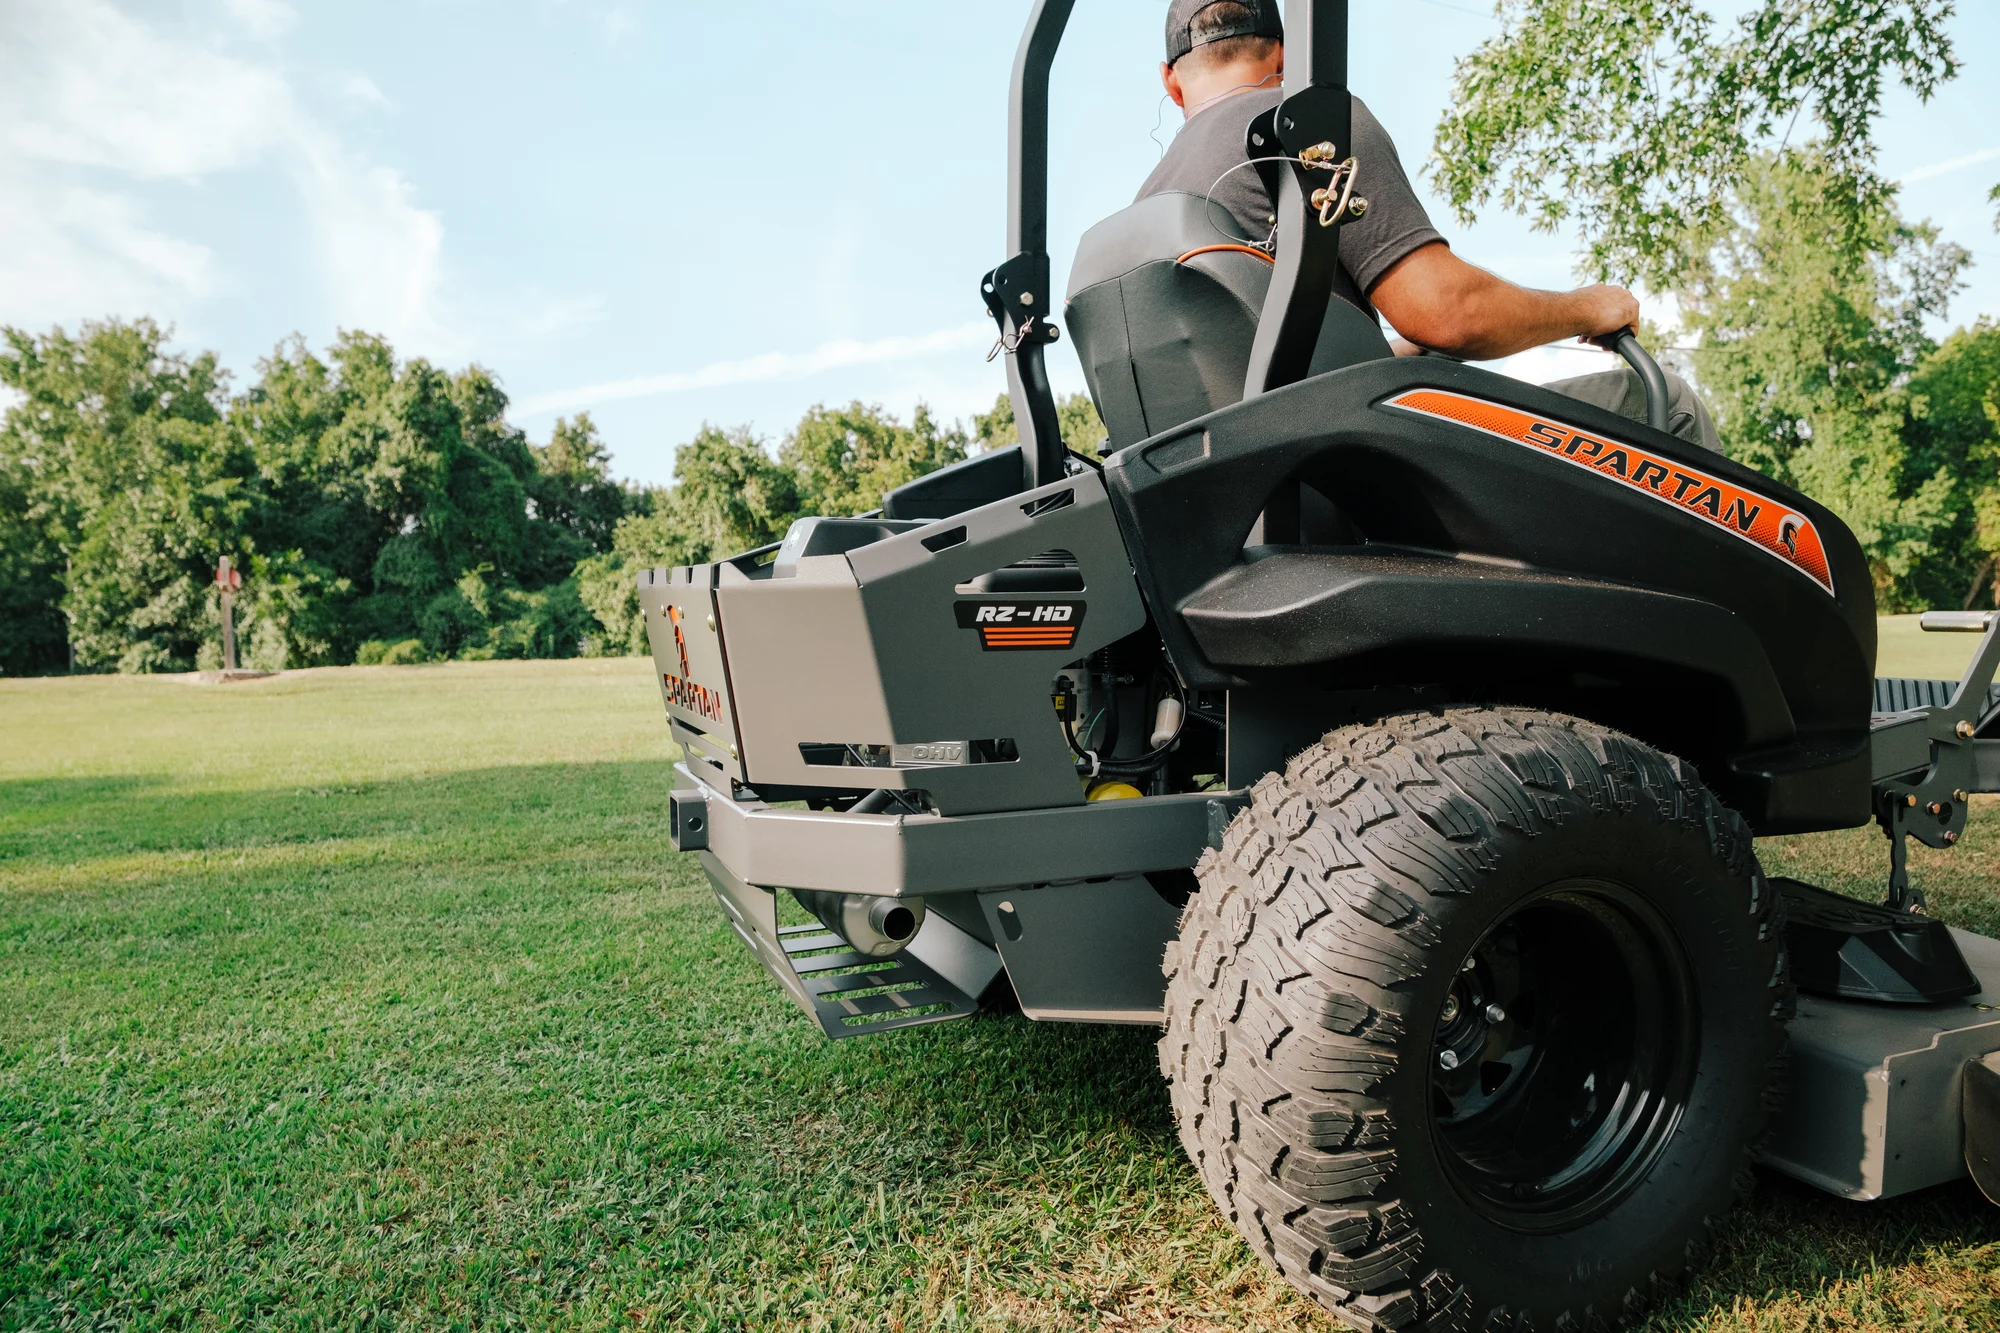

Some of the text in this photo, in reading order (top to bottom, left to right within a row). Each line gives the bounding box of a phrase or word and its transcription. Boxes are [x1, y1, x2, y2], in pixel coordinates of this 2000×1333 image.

[1524, 422, 1760, 532] SPARTAN
[976, 605, 1073, 622] RZ-HD
[663, 673, 723, 724] SPARTAN
[913, 745, 962, 761] OHV
